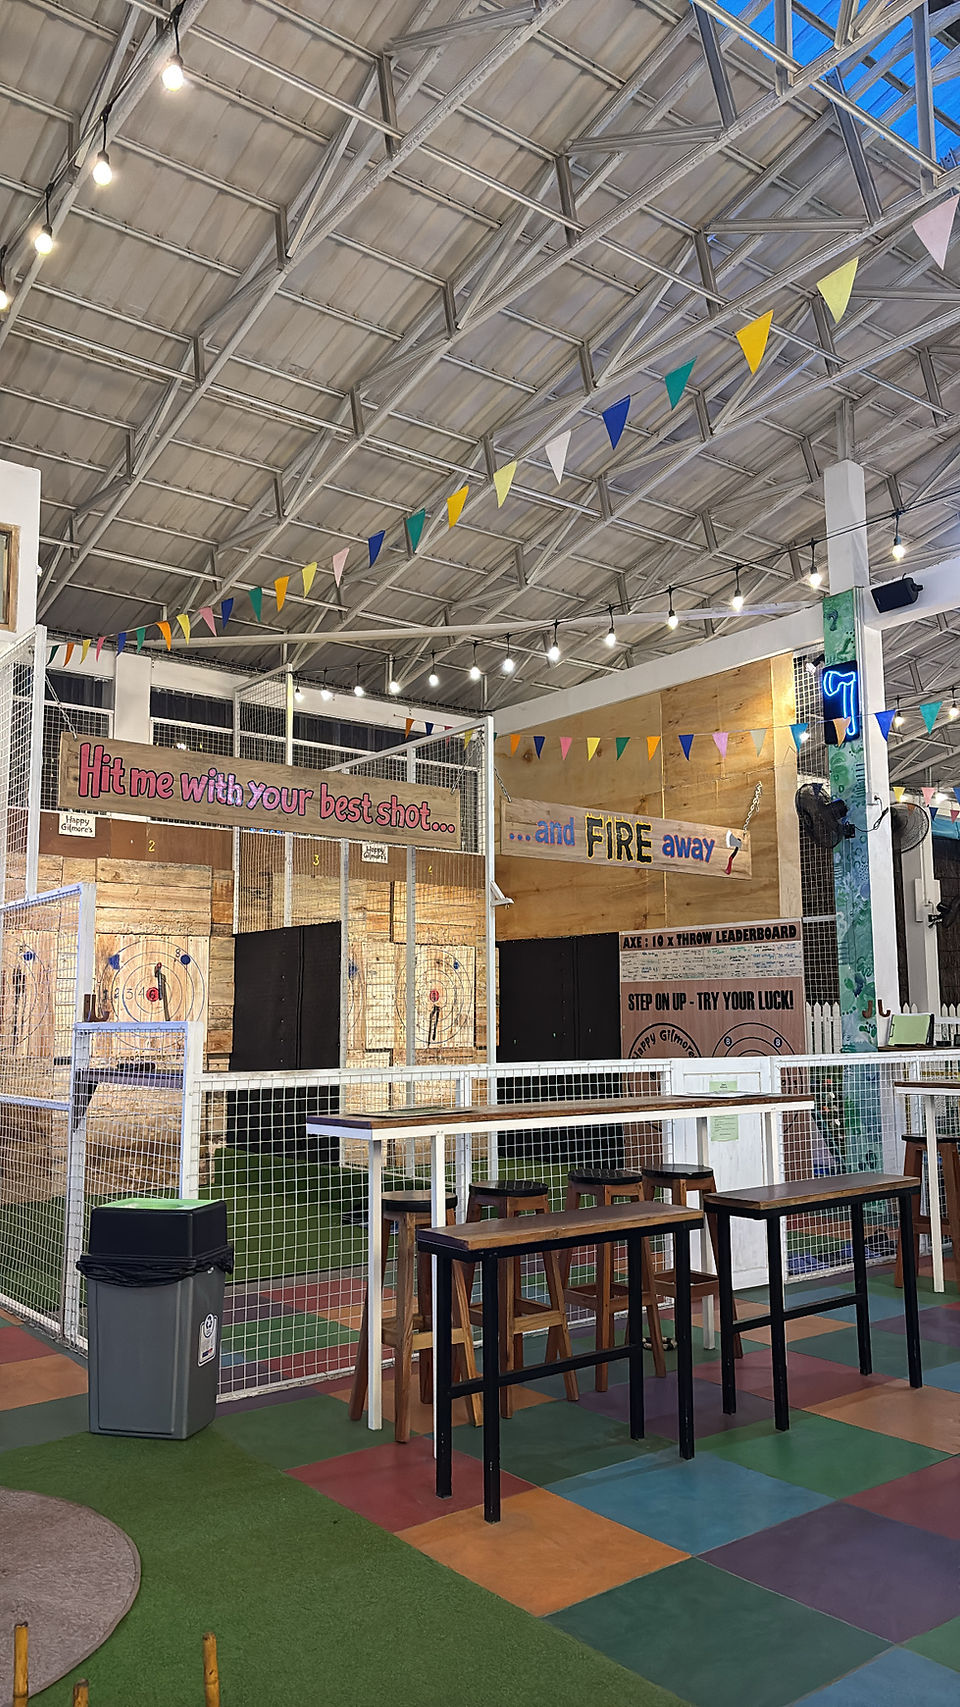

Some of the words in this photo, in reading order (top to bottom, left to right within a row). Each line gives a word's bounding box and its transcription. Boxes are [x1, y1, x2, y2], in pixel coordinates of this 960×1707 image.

[78, 742, 125, 798] Hit
[130, 768, 174, 799] me
[180, 767, 243, 807] with
[246, 780, 314, 816] your
[320, 782, 373, 824] best
[376, 794, 456, 833] shot...
[61, 823, 93, 833] Gilmore's
[65, 815, 89, 826] Happy
[148, 840, 155, 852] 2
[509, 817, 575, 846] ...and
[585, 812, 653, 864] FIRE
[662, 834, 715, 863] away
[312, 854, 319, 866] 3
[623, 936, 642, 949] AXE
[652, 935, 664, 946] 10
[676, 931, 713, 946] THROW
[716, 924, 797, 944] LEADERBOARD
[628, 992, 653, 1011] STEP
[655, 993, 670, 1010] ON
[672, 992, 687, 1010] UP
[696, 991, 719, 1010] TRY
[723, 991, 754, 1010] YOUR
[758, 990, 793, 1010] LUCK!
[659, 1029, 697, 1058] Gilmore
